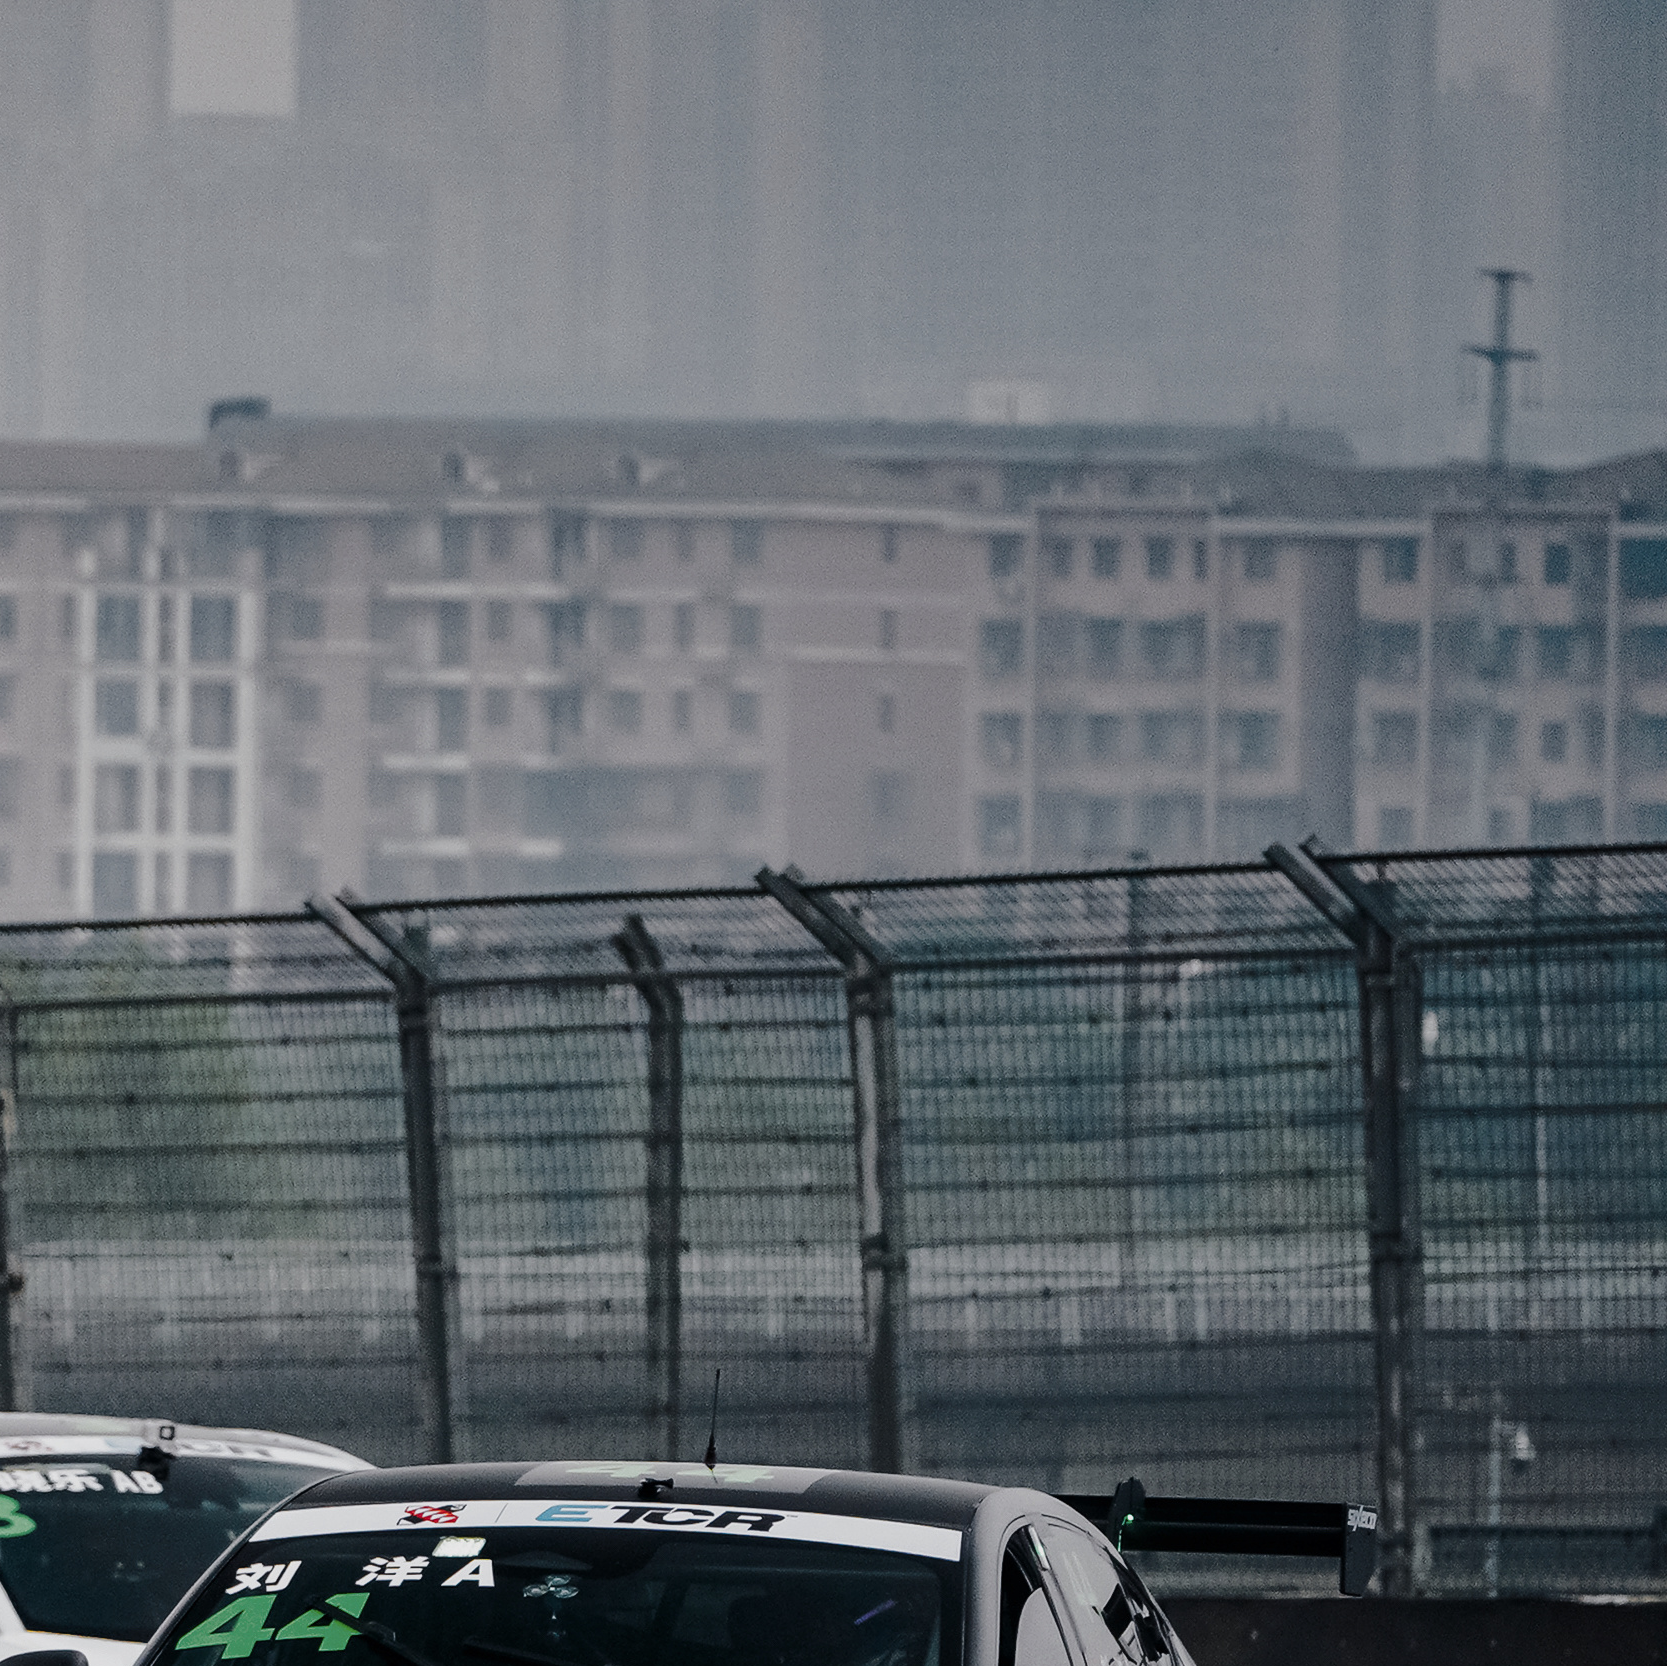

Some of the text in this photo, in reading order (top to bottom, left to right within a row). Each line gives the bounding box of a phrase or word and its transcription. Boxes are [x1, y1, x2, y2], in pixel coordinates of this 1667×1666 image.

[111, 1469, 164, 1494] AB
[534, 1503, 786, 1533] ETCR
[440, 1558, 495, 1587] A
[174, 1591, 371, 1660] 44
